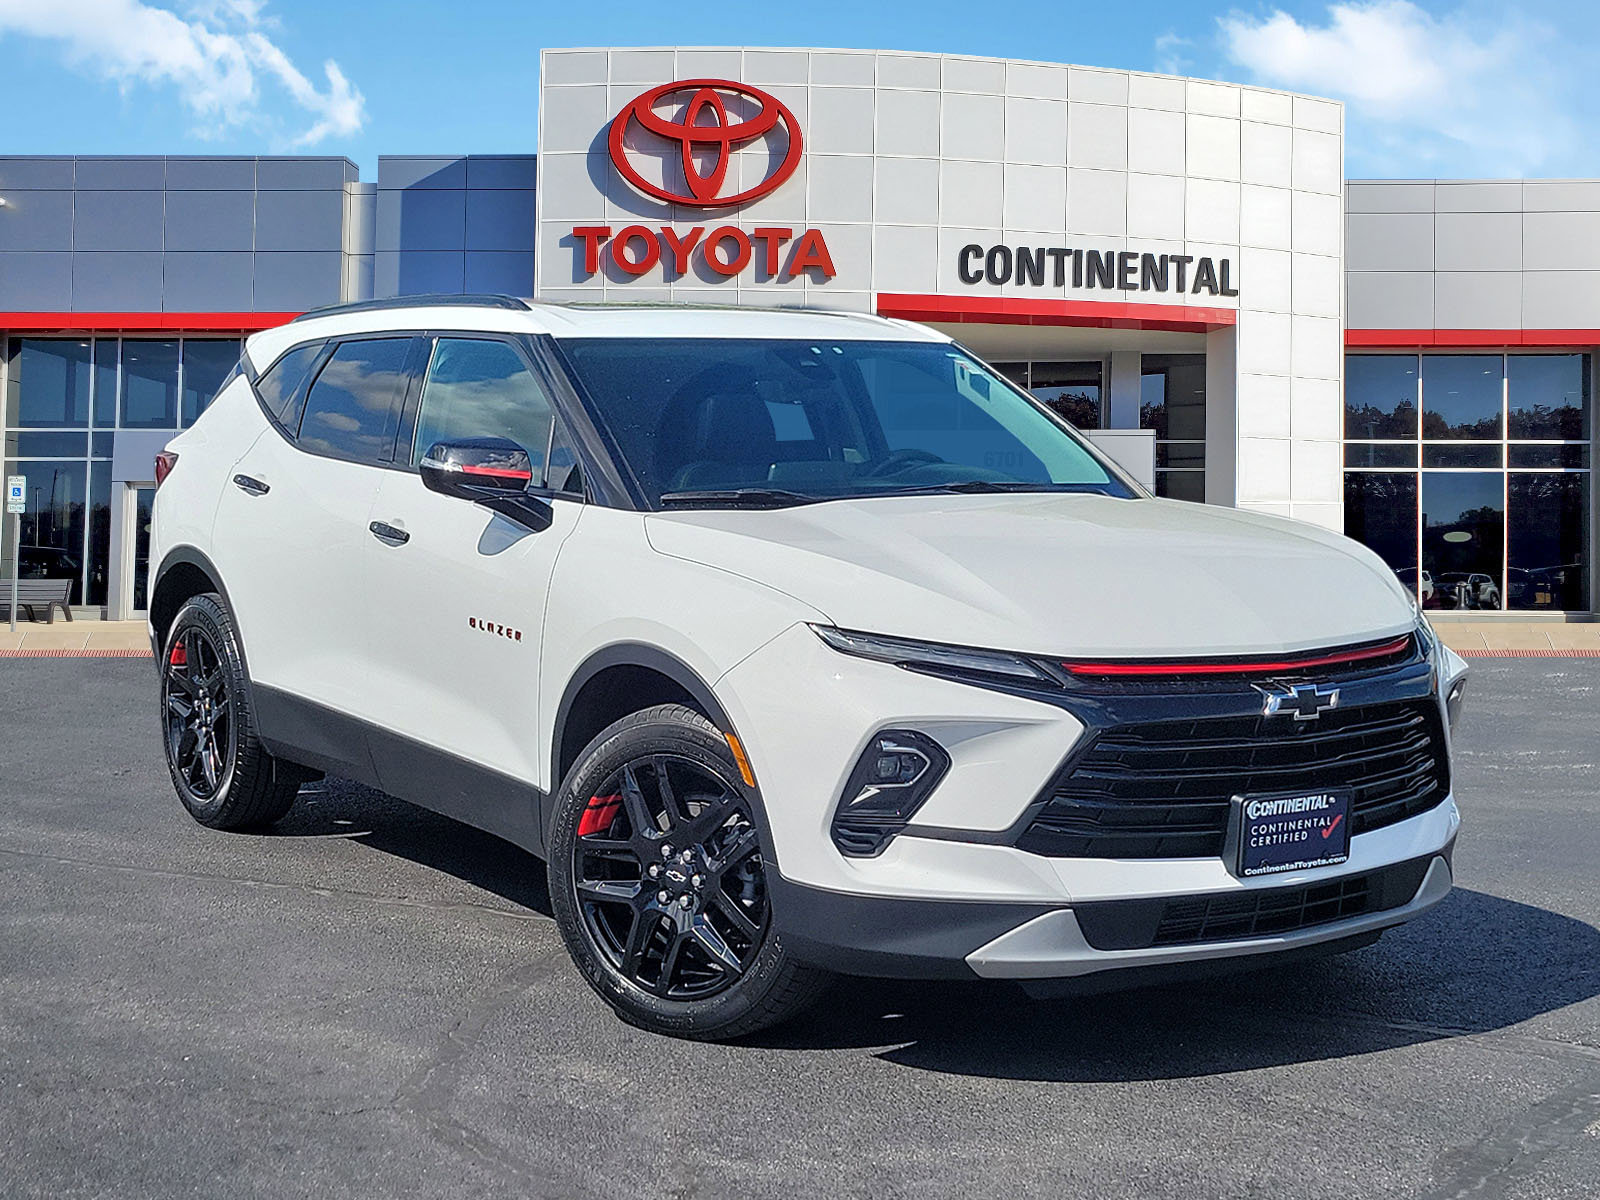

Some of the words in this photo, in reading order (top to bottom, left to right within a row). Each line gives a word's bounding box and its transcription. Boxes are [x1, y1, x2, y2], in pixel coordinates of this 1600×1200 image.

[573, 224, 837, 277] TOYOTA
[958, 244, 1239, 297] CONTINENTAL
[469, 617, 522, 643] BLAZER
[1247, 795, 1330, 819] CONTINENTAL
[1251, 816, 1332, 835] CONTINENTAL
[1250, 831, 1308, 847] CERTIFIED
[1244, 856, 1348, 876] ContinentalToyota.com
